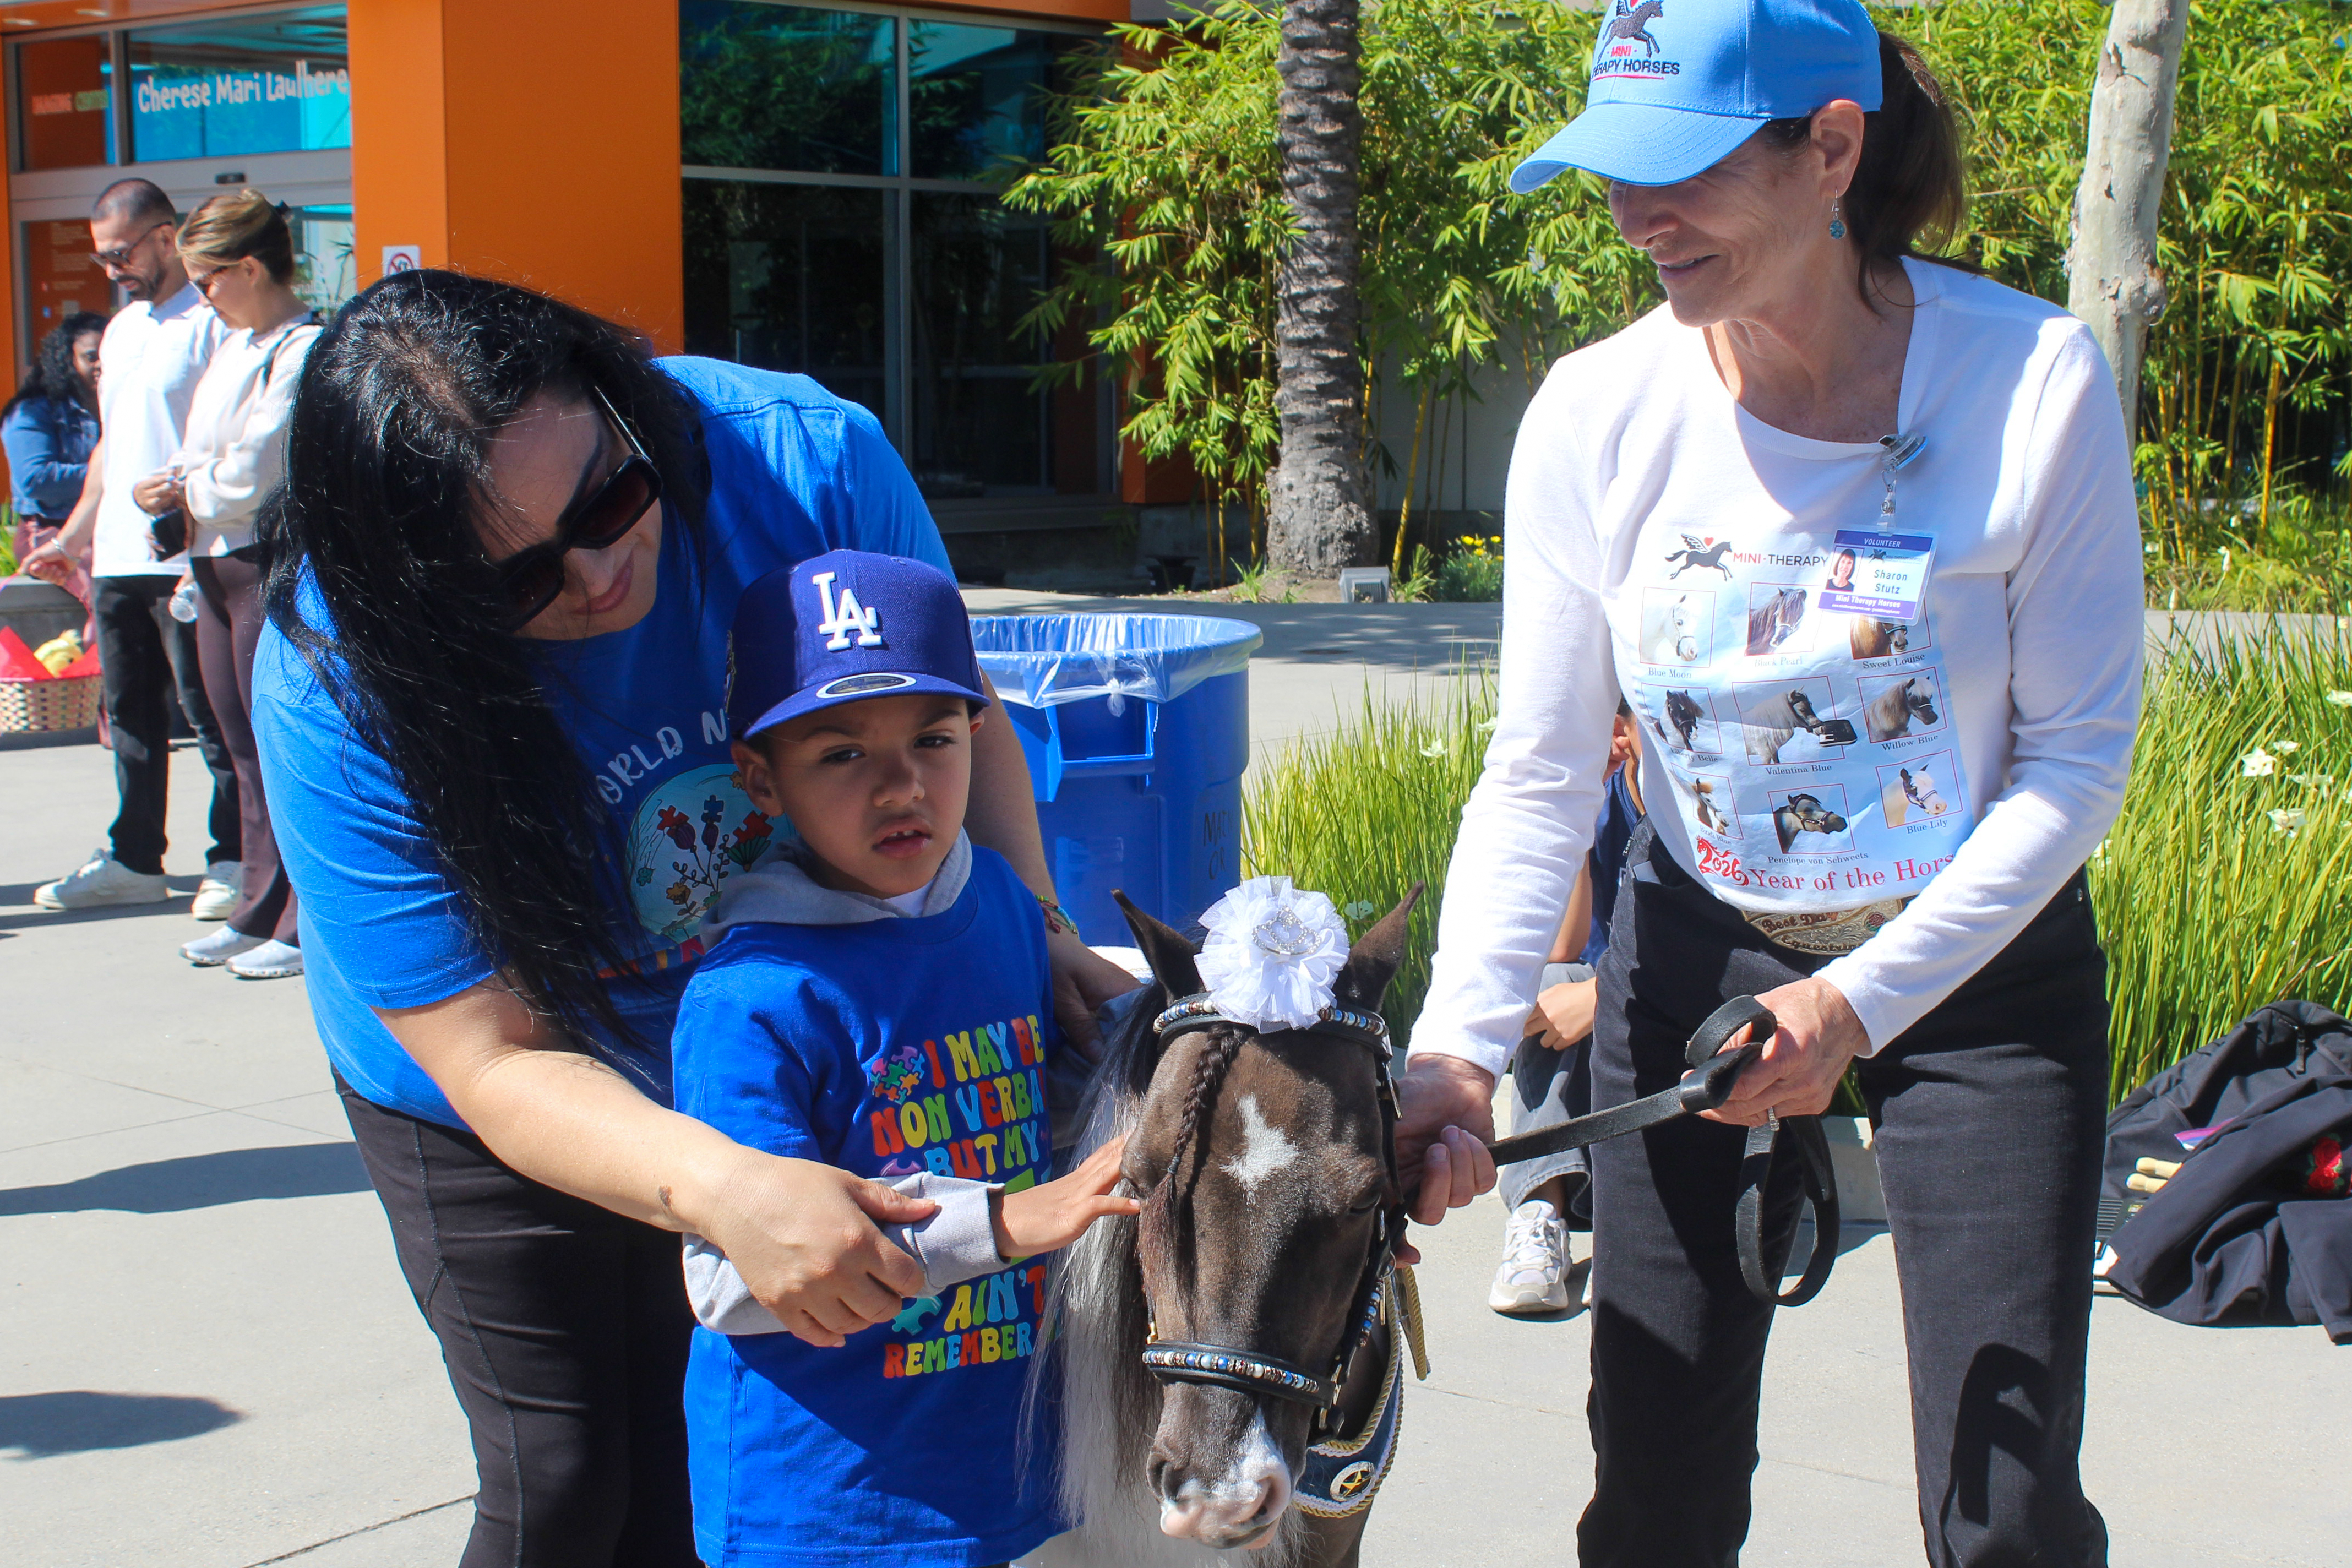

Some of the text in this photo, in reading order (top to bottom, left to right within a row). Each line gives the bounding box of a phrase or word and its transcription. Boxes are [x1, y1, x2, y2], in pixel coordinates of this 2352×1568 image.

[1611, 45, 1632, 57] MINI
[1624, 59, 1680, 75] HORSES
[138, 75, 211, 112] Cherese
[216, 72, 260, 104] Mari
[266, 59, 349, 101] Laulhere
[1864, 538, 1901, 547] VOLUNTEER
[1733, 553, 1828, 567] MINI THERAPY
[1874, 569, 1908, 581] Sharon
[1875, 583, 1901, 594] Stutz
[1835, 594, 1901, 608] Mini Therapy Horses
[813, 571, 882, 651] LA
[1755, 656, 1803, 667] Black Pearl
[1894, 654, 1925, 666] Louise
[1648, 667, 1691, 678] Blue Moon
[1881, 734, 1938, 751] Willow Blue
[596, 727, 683, 804] ORLD
[1766, 766, 1809, 775] Valentina
[1907, 819, 1948, 834] Blue Lily
[1700, 825, 1732, 845] Bindi Blue
[1695, 834, 1954, 891] 2026 Year of the Hors
[1767, 856, 1807, 865] Penelope
[1826, 852, 1869, 864] Schweets
[1762, 916, 1798, 933] Best
[923, 1015, 1044, 1088] I MAY BE
[870, 1093, 952, 1157] NON
[924, 1120, 1039, 1179] BUT MY
[944, 1264, 1046, 1332] AIN'T
[883, 1322, 1033, 1379] REMEMBER
